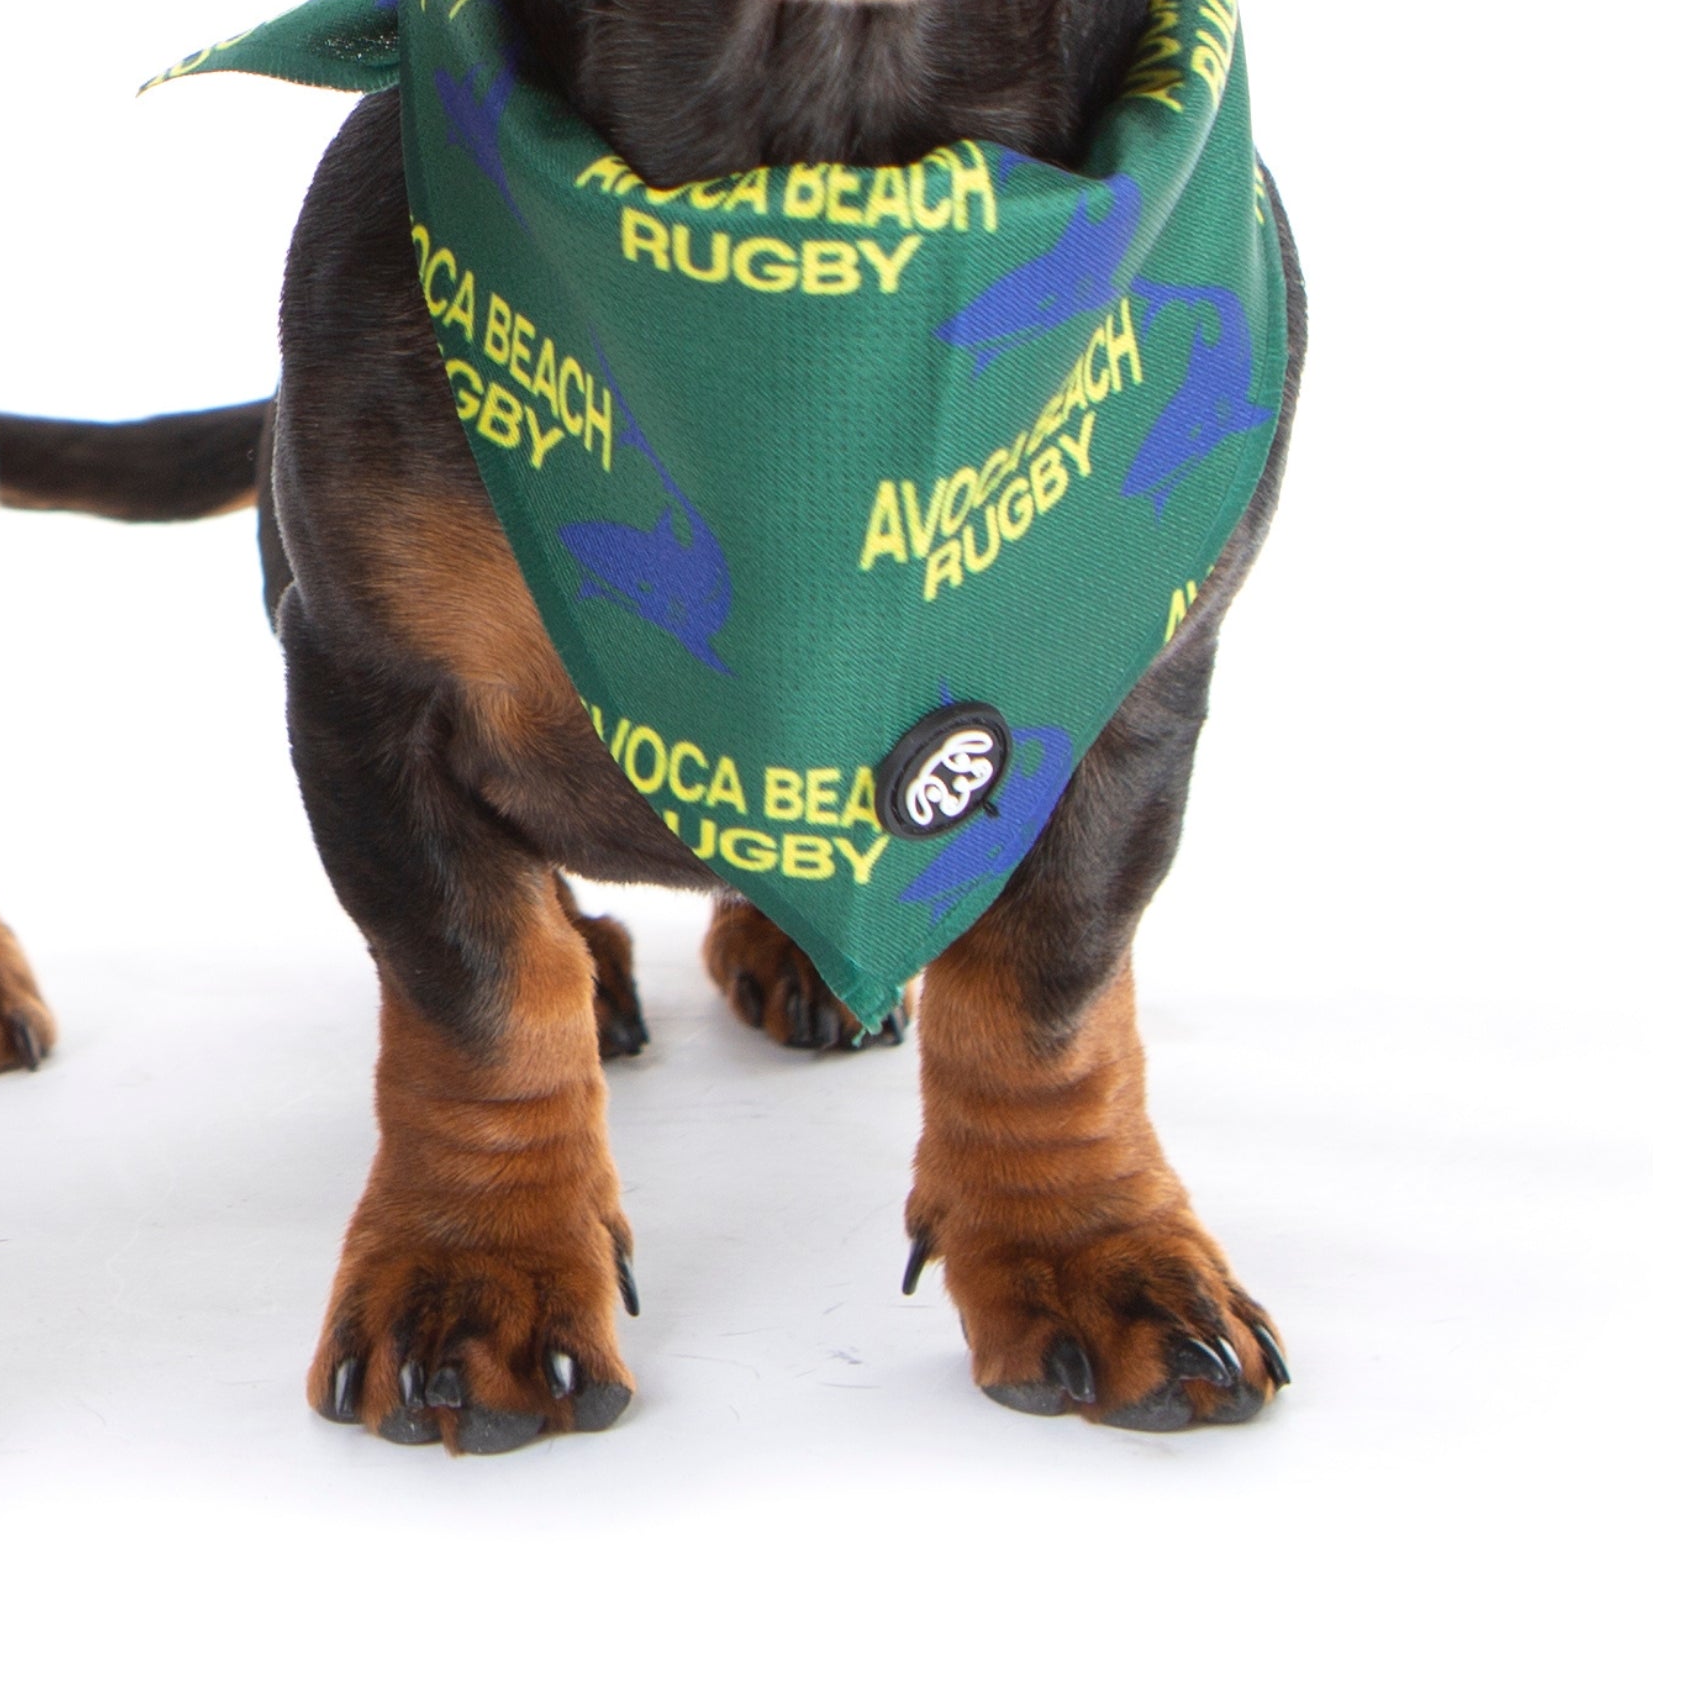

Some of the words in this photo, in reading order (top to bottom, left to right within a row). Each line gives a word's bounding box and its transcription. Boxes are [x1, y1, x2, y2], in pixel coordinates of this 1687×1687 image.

[621, 206, 924, 296] RUGBY
[782, 138, 997, 234] BEACH
[484, 291, 612, 474] BEACH
[923, 410, 1097, 603] RUGBY
